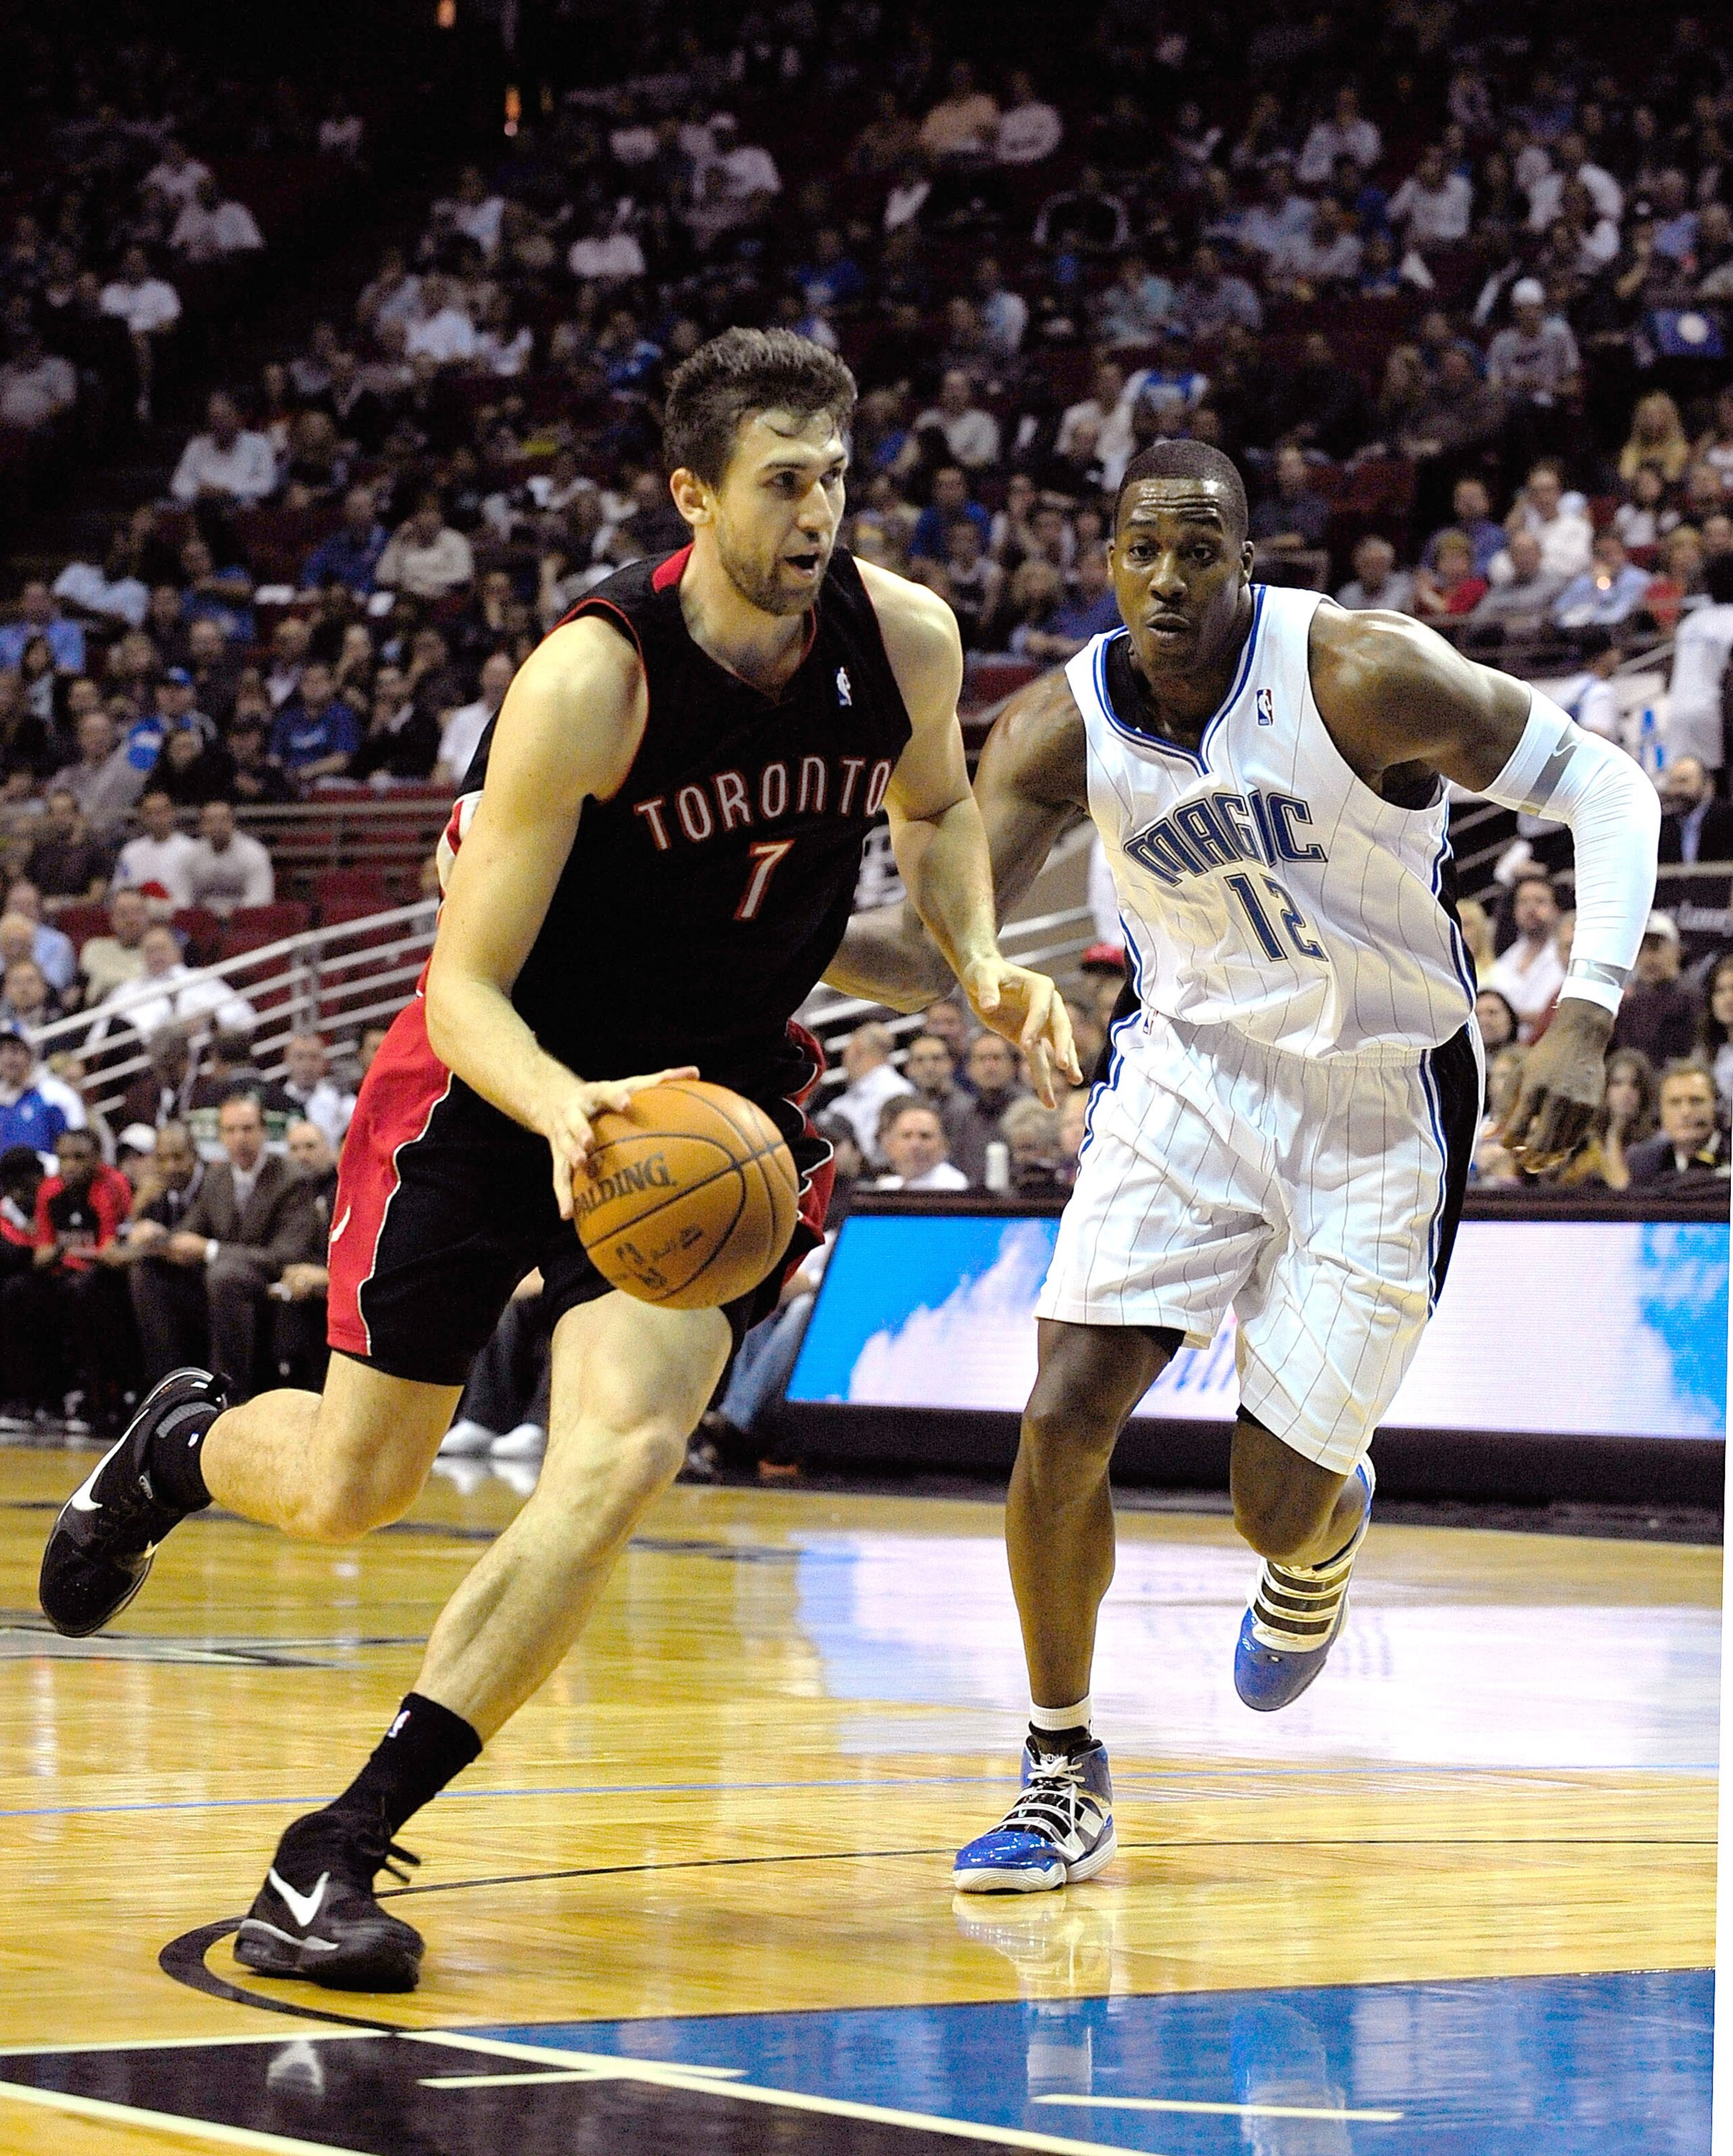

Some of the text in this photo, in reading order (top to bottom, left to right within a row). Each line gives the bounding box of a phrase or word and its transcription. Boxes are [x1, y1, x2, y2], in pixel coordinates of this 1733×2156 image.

[634, 756, 892, 850] TORONTO
[1124, 790, 1328, 887] MAGIC
[734, 839, 795, 922] 7
[1223, 873, 1329, 962] 12
[574, 1152, 672, 1213] ALDING
